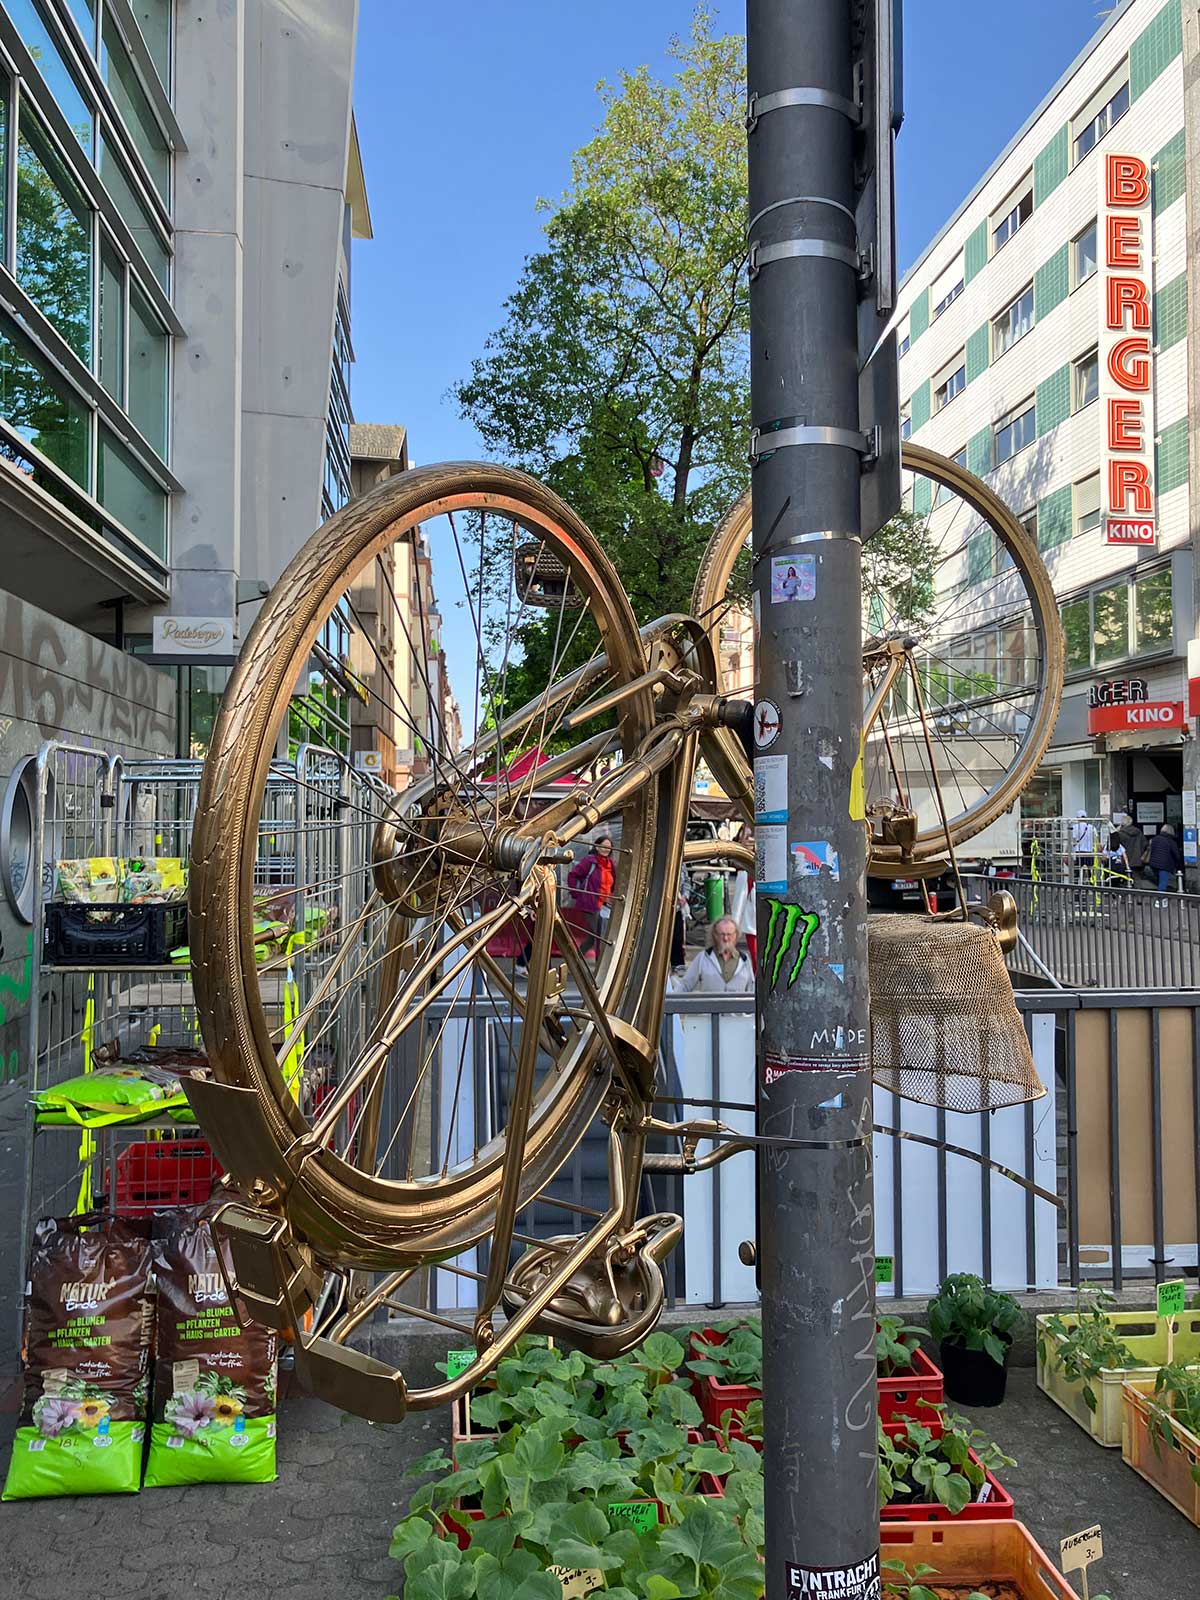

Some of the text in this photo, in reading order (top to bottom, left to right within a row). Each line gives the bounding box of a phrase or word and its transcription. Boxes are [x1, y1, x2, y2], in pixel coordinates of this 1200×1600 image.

[1106, 154, 1152, 512] BERGER
[1110, 524, 1152, 540] KINO
[162, 619, 223, 641] Radeberger
[1127, 707, 1174, 723] KINO
[59, 1281, 107, 1303] NATUR
[194, 1287, 226, 1303] Erde
[65, 1296, 98, 1311] Erde
[77, 1315, 106, 1326] BLUMEN
[186, 1318, 220, 1329] PFLANZEN
[57, 1327, 91, 1338] PFLANZEN
[186, 1329, 204, 1340] HAUS
[214, 1327, 241, 1338] GARTEN
[83, 1336, 112, 1347] GARTEN
[790, 1554, 877, 1591] EINTRACHT
[816, 1581, 867, 1600] FRANKFURT
